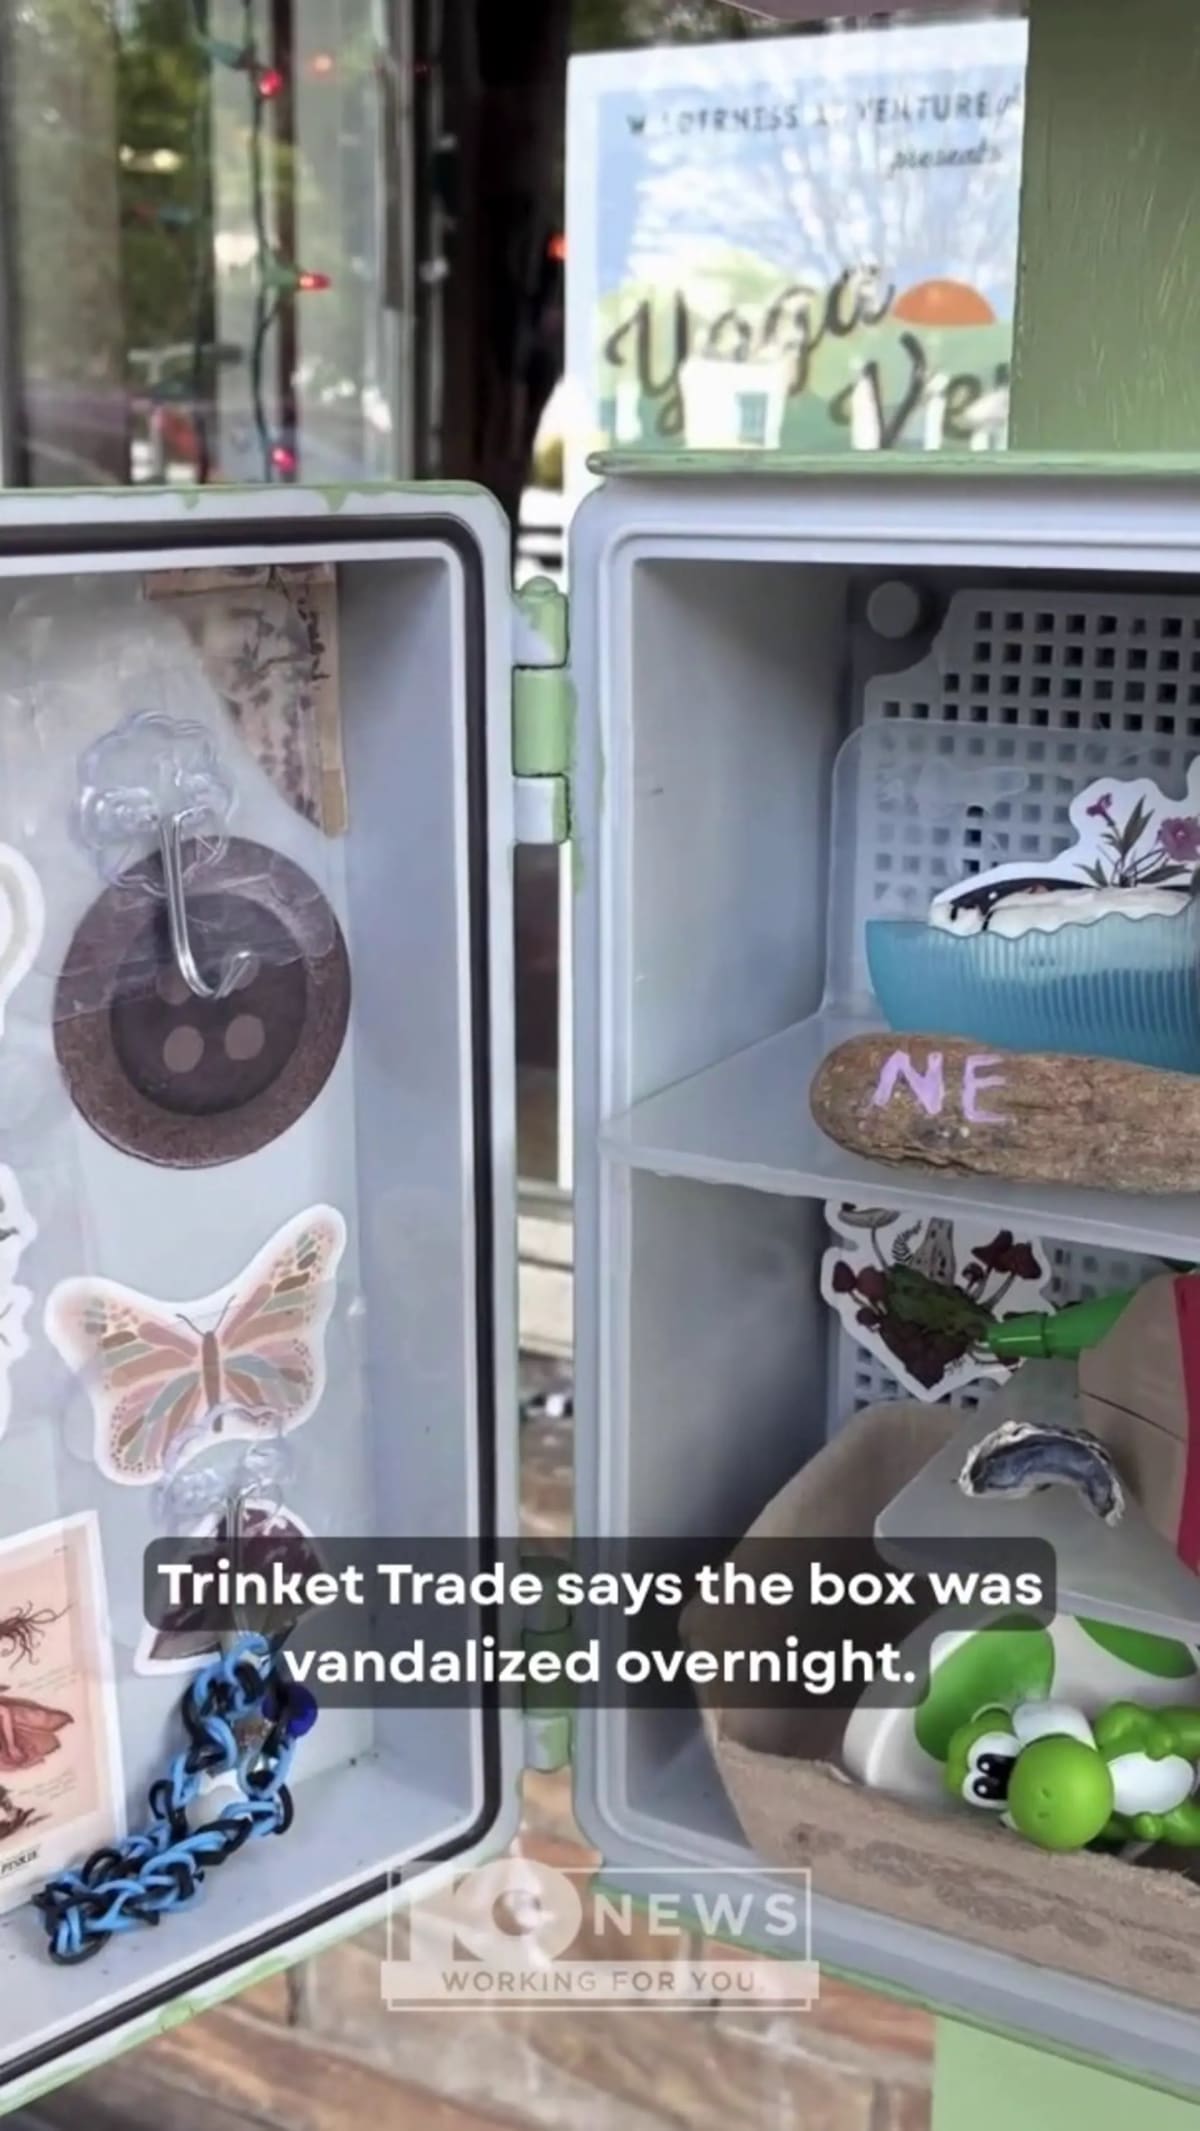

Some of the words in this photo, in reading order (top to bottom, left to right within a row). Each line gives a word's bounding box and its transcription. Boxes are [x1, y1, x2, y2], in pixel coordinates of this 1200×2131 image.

[605, 265, 895, 436] Yoga
[830, 333, 1009, 450] Ve
[872, 1050, 1010, 1122] NE
